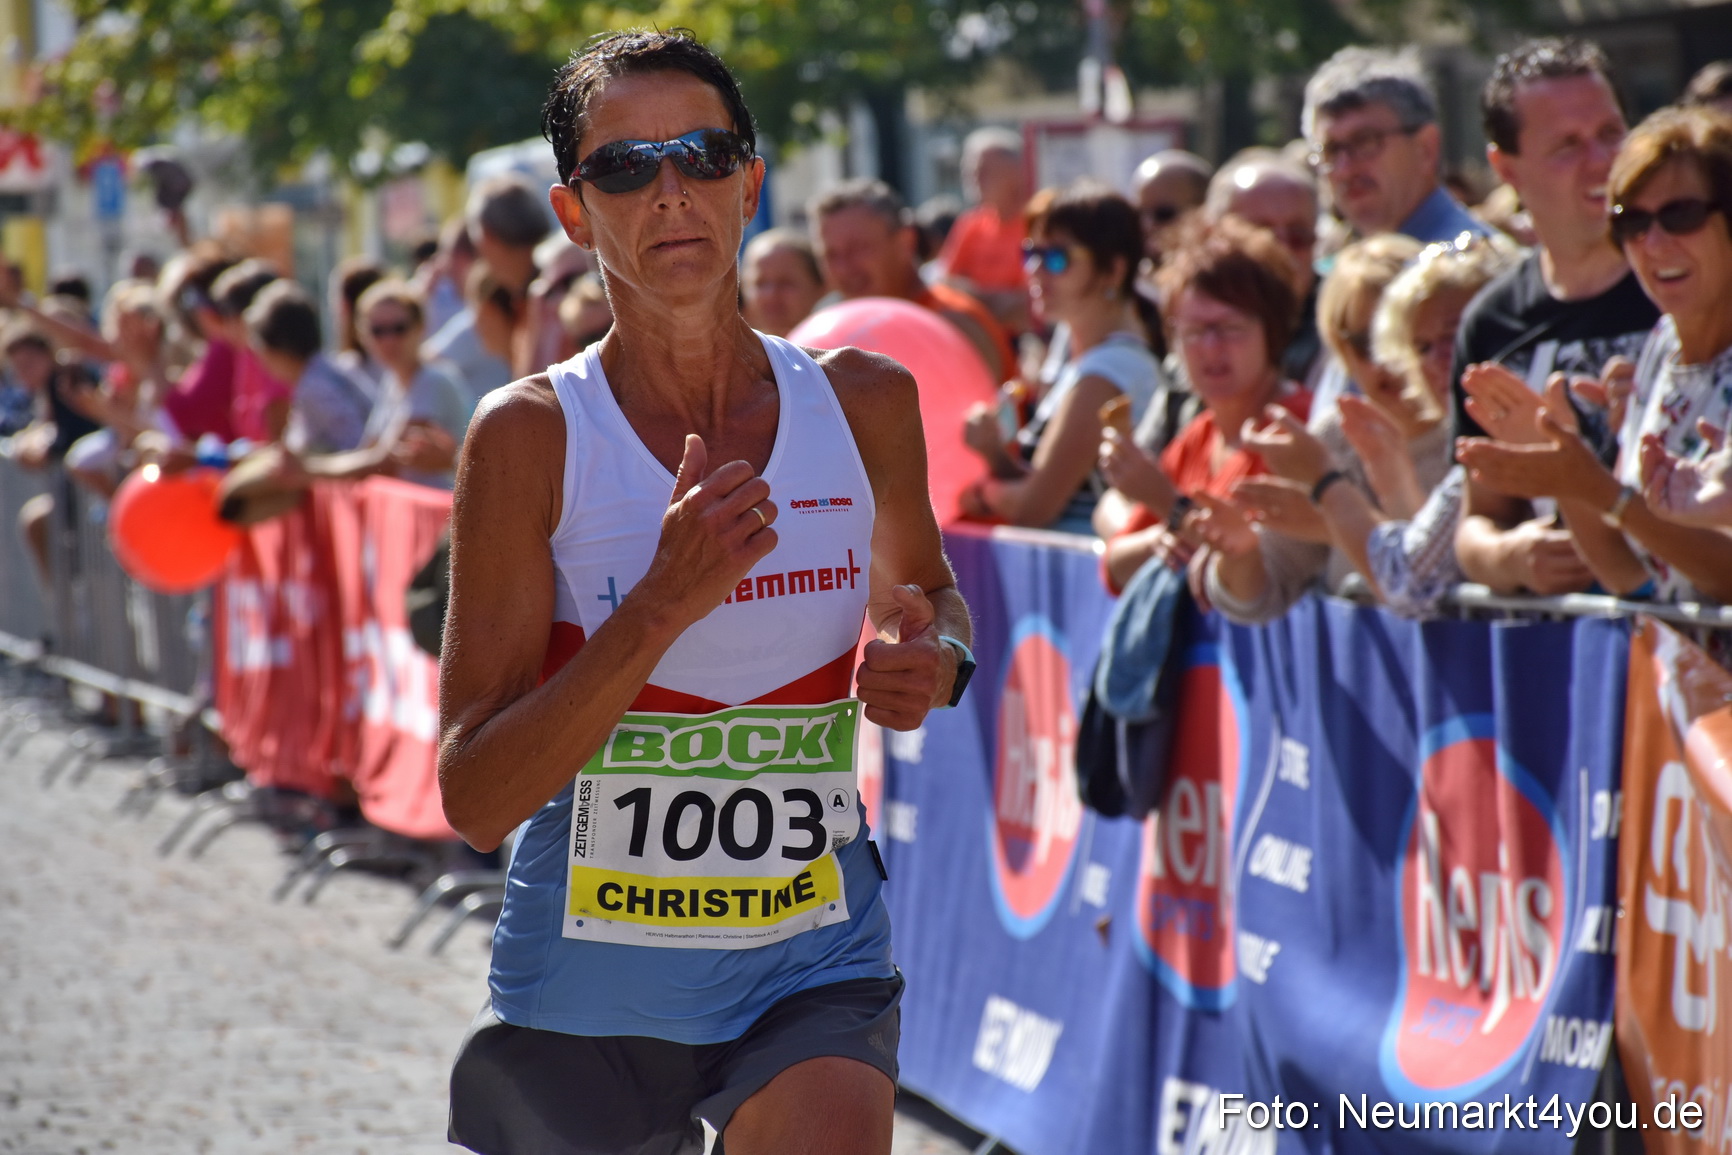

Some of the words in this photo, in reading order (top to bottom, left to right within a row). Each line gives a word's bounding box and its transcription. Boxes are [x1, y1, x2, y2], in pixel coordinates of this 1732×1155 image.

[605, 716, 836, 768] BOCK
[612, 787, 827, 862] 1003
[833, 794, 845, 808] A
[589, 817, 598, 859] TRANSPONDER
[596, 870, 816, 918] CHRISTINE
